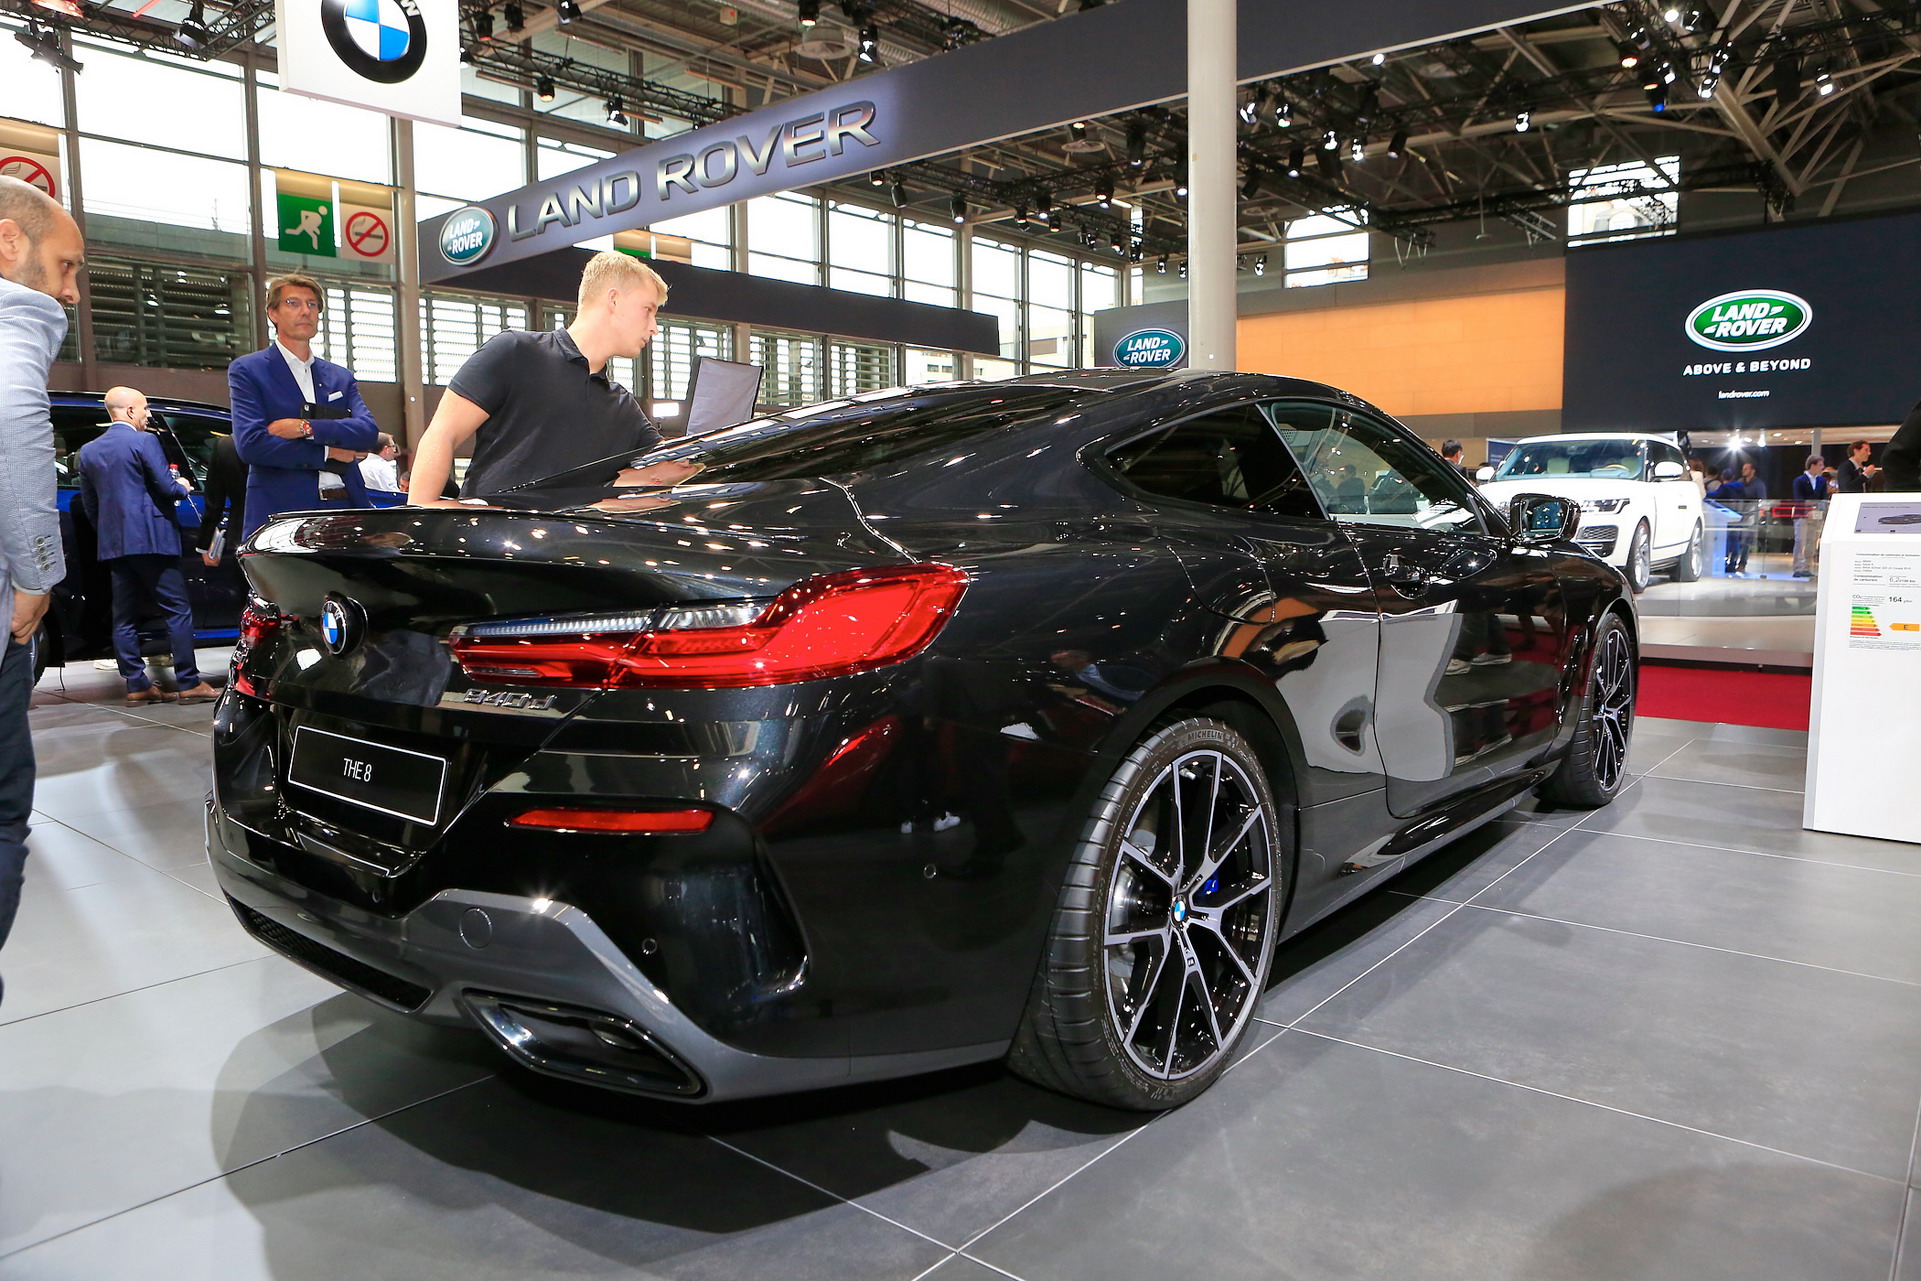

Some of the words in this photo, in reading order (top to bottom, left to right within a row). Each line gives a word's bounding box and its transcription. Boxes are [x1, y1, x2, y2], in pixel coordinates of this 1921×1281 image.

[507, 170, 642, 242] LAND
[656, 100, 881, 201] ROVER
[449, 218, 475, 239] LAND
[452, 231, 483, 255] ROVER
[1711, 302, 1771, 322] LAND
[1714, 317, 1788, 338] ROVER
[1127, 336, 1161, 352] LAND
[1130, 348, 1171, 364] ROVER
[1682, 362, 1732, 376] ABOVE
[1735, 361, 1746, 373] &
[1749, 357, 1811, 373] BEYOND
[1718, 389, 1770, 399] landrover.com
[463, 687, 558, 710] 840d
[1187, 730, 1223, 742] MICHELIN
[343, 757, 364, 780] THE
[363, 763, 372, 782] 8
